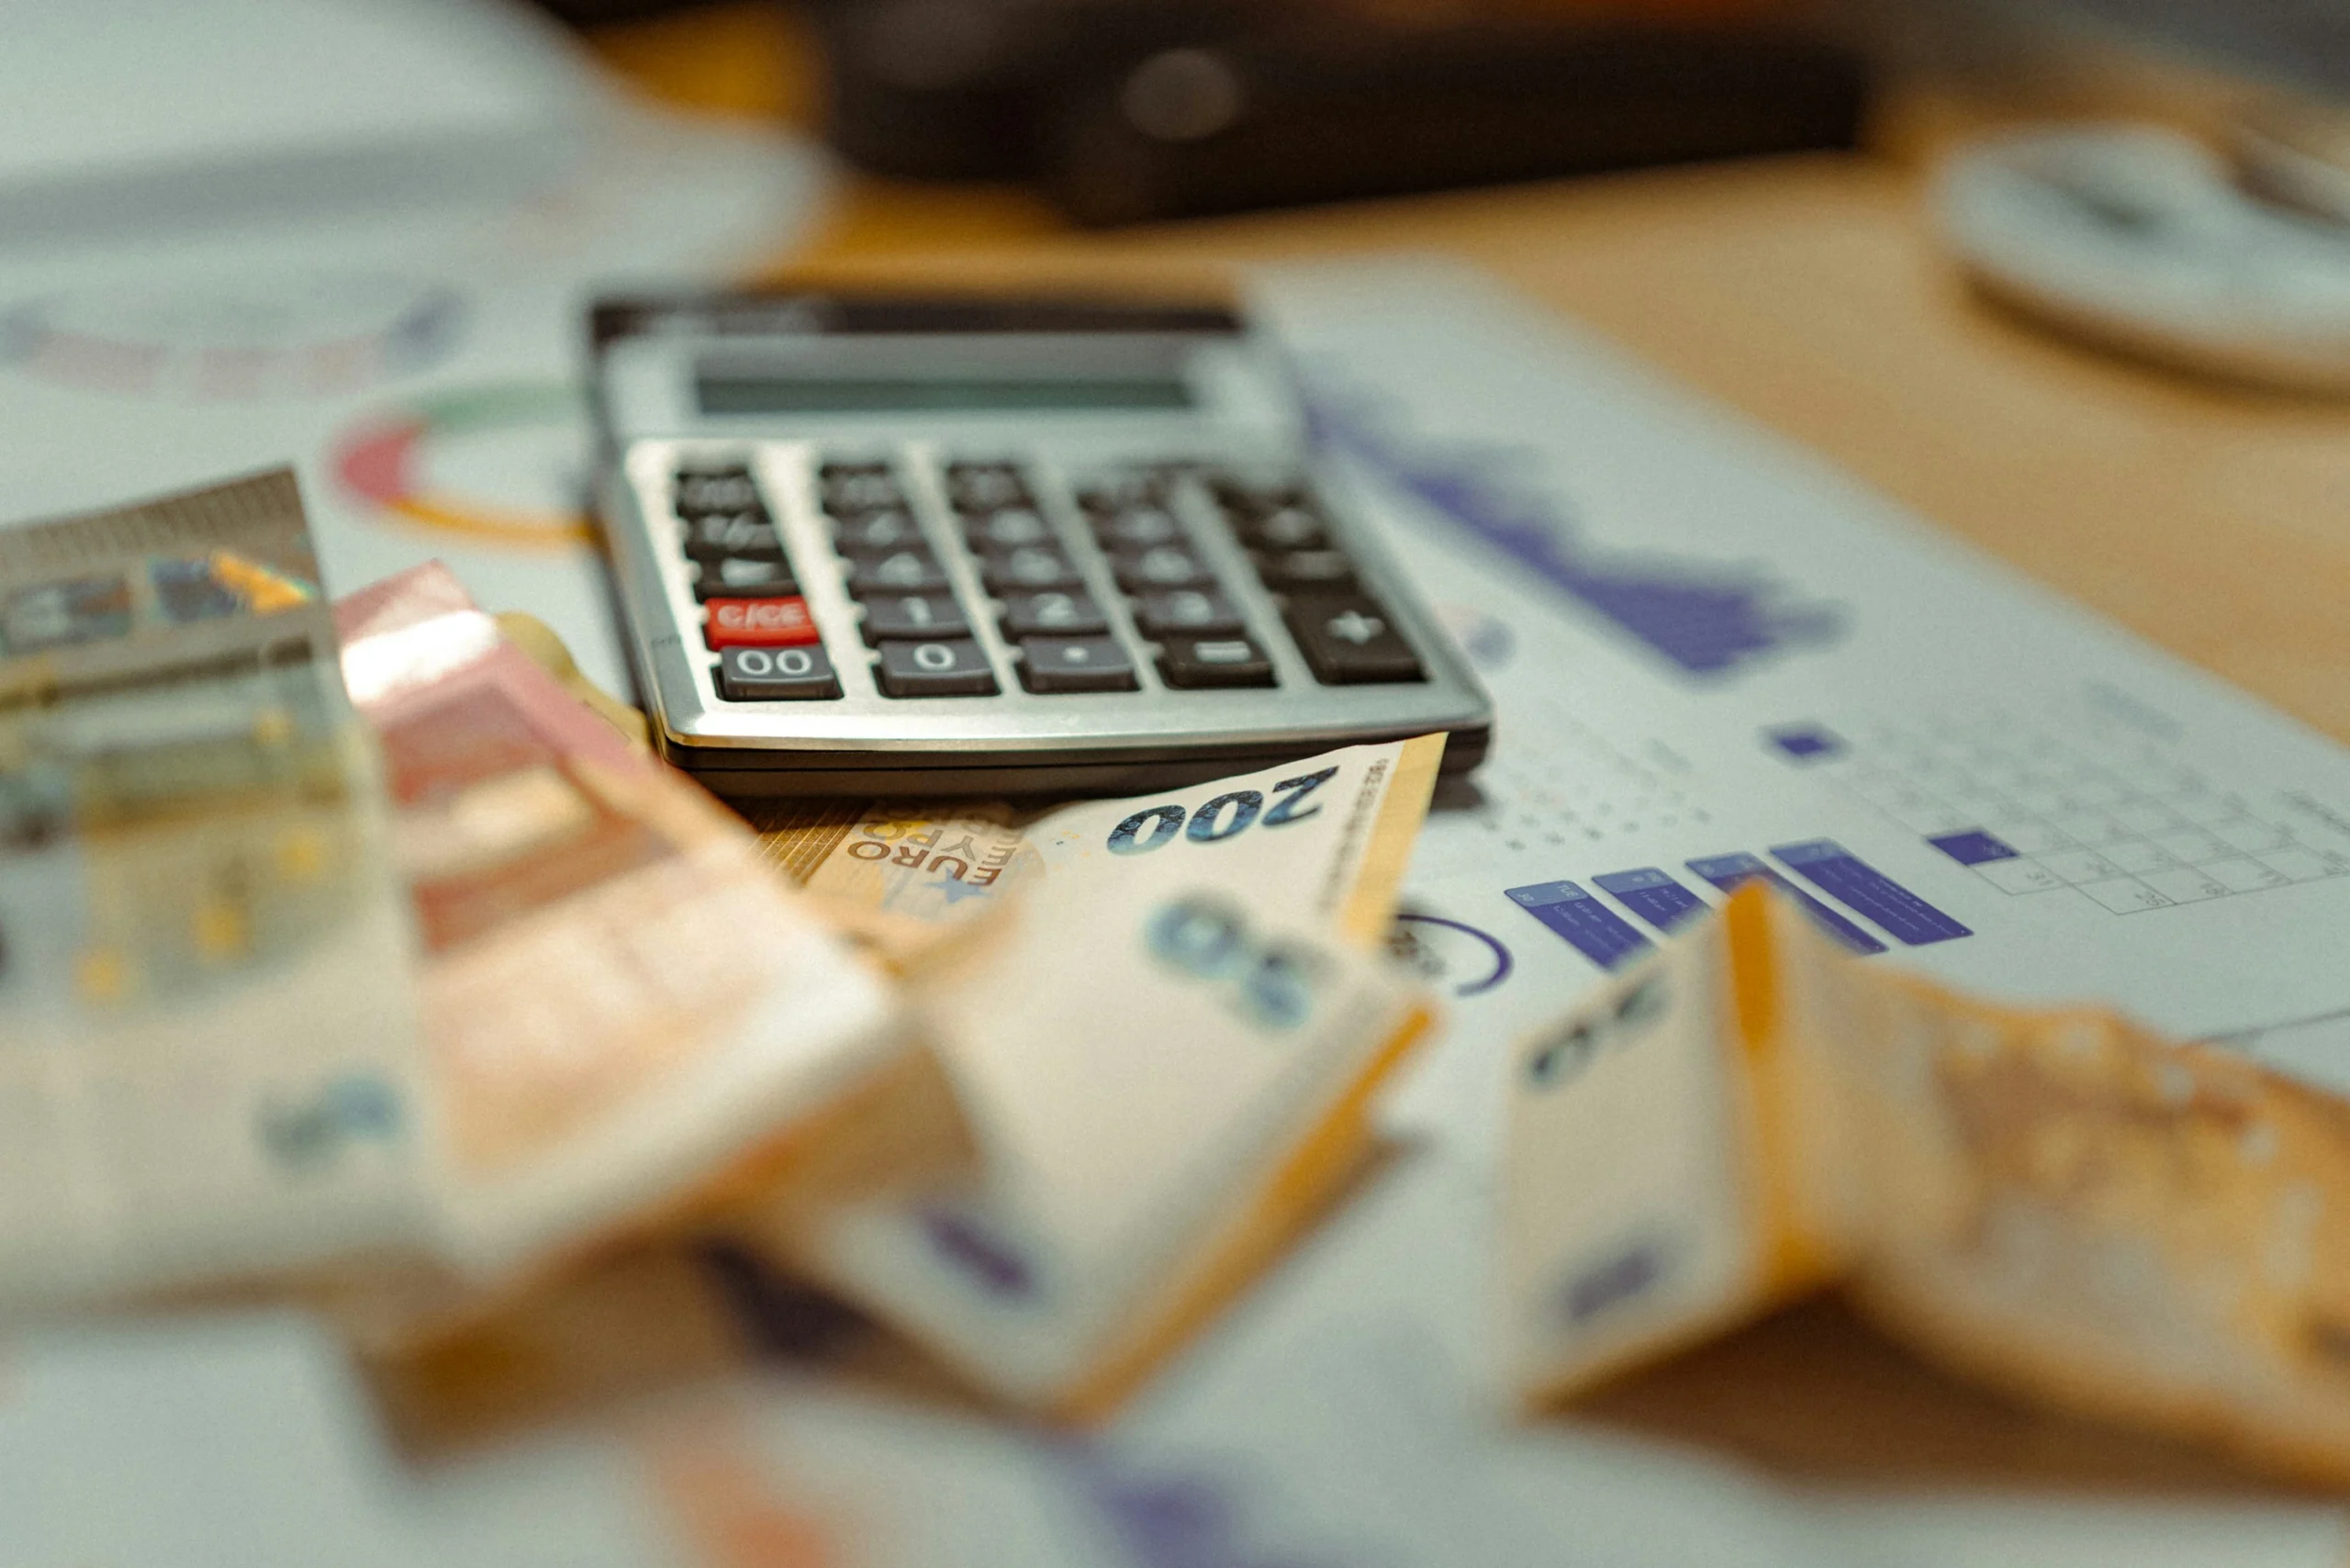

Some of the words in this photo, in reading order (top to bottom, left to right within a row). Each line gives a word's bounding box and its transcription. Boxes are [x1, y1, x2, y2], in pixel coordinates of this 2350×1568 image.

[718, 603, 804, 630] C/CE
[736, 649, 811, 676] 00
[914, 644, 956, 671] 0
[1106, 766, 1340, 856] 200
[847, 840, 1003, 887] EURO
